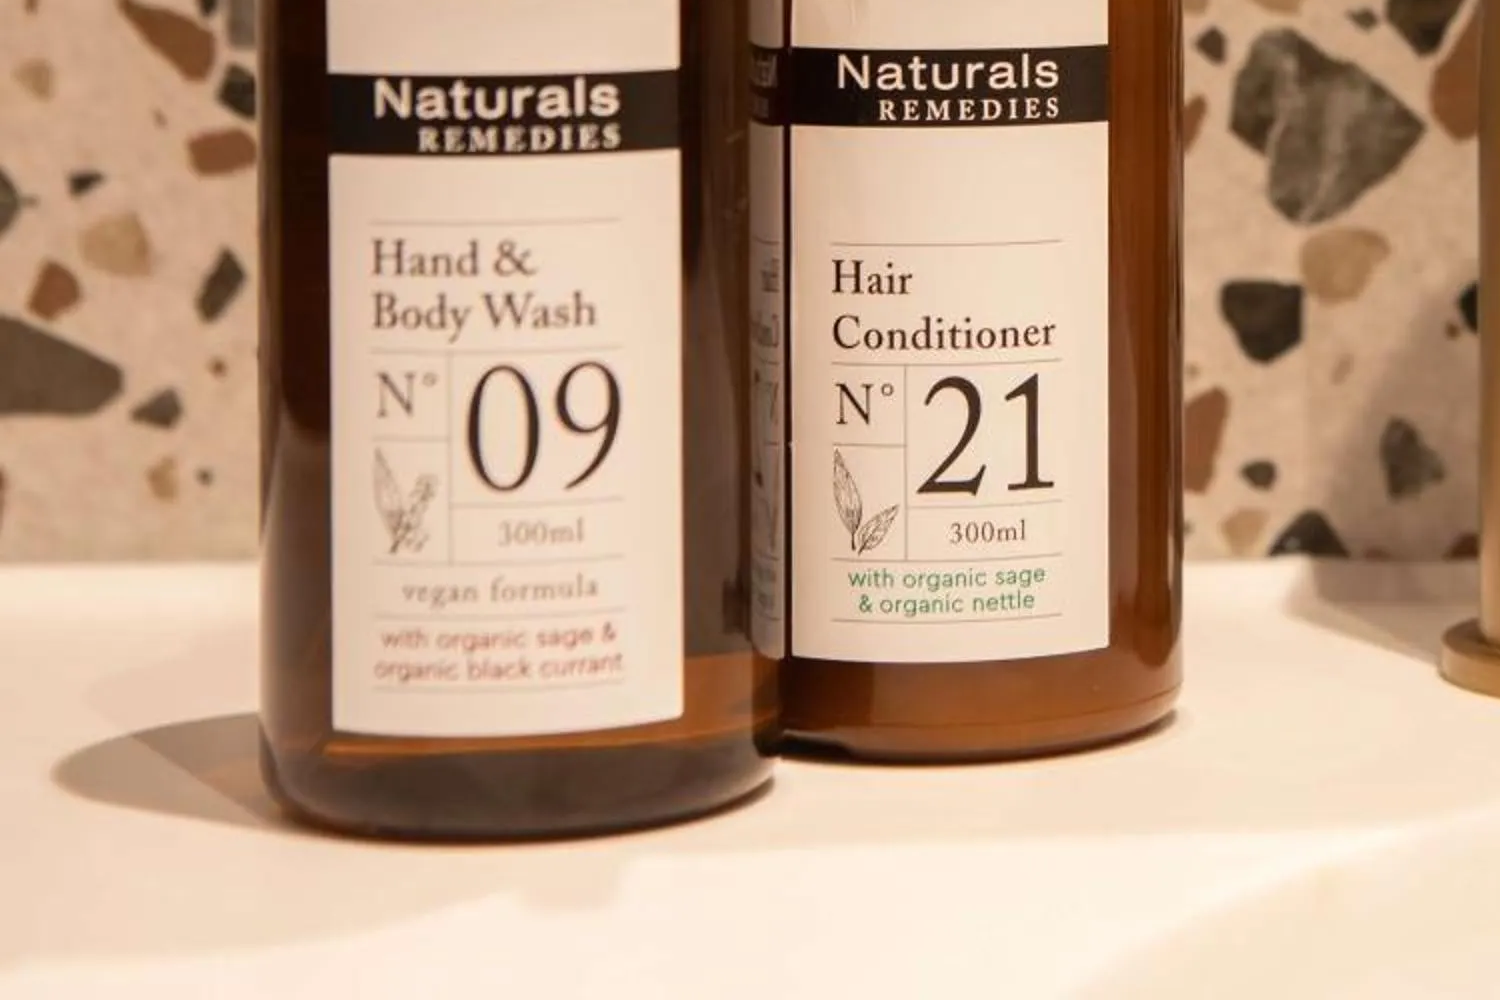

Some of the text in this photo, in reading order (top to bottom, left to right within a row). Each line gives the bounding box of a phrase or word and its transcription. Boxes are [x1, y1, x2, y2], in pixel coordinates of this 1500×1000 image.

[837, 53, 1060, 91] Naturals
[373, 76, 620, 121] Naturals
[879, 97, 1060, 122] REMEDIES
[418, 123, 621, 153] REMEDIES
[371, 238, 538, 278] Hand &
[831, 259, 913, 296] Hair
[372, 290, 597, 342] Body Wash
[832, 315, 1056, 351] Conditioner
[467, 361, 621, 493] 09
[916, 373, 1055, 496] 21
[498, 517, 585, 548] 300ml
[949, 518, 1027, 545] 300ml
[402, 573, 599, 608] vegan formula
[848, 565, 1046, 593] with organic sage
[858, 590, 1036, 618] & organic nettle
[381, 621, 617, 653] with organic sage &
[373, 651, 622, 684] organic black currant
